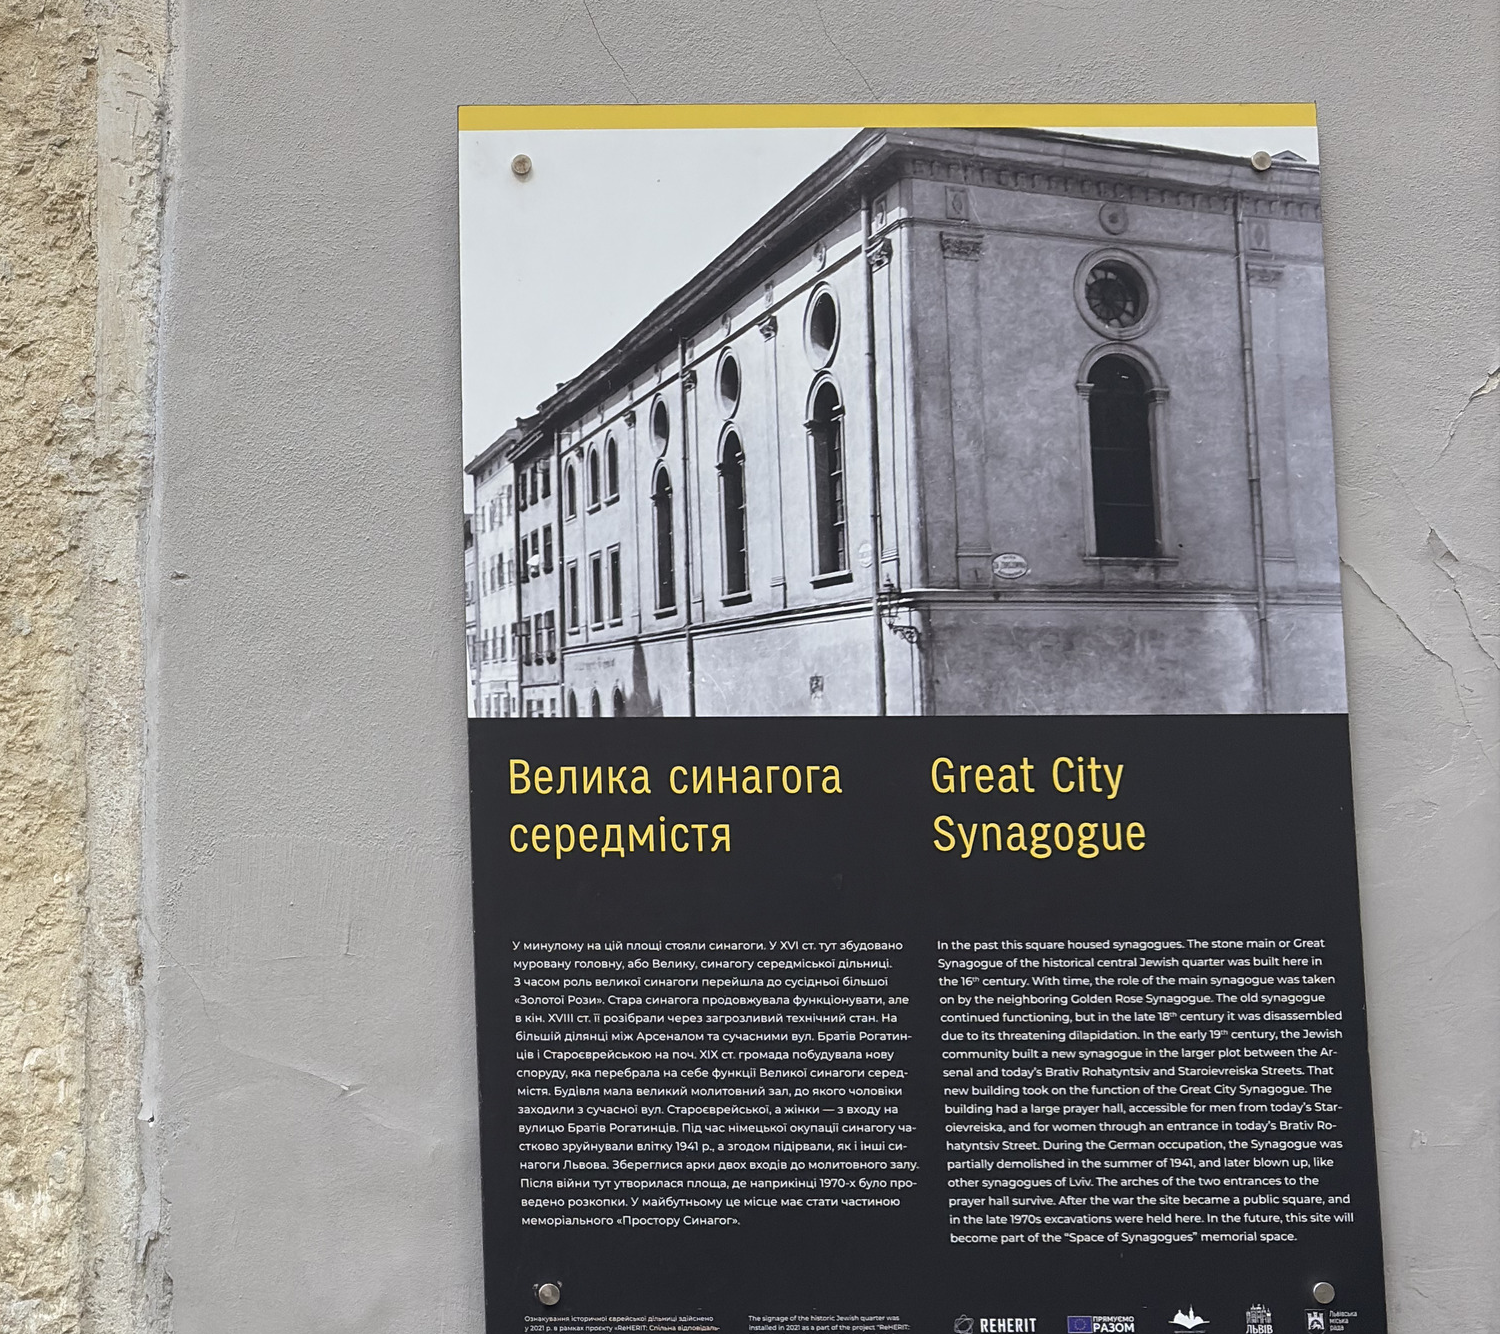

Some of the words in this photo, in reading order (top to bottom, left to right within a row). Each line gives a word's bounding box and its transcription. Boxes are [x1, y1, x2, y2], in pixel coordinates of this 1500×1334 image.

[509, 758, 651, 794] Велика
[669, 765, 842, 794] синагога
[931, 757, 1035, 793] Great
[1052, 756, 1123, 799] City
[509, 815, 730, 859] середмістя
[933, 815, 1145, 858] Synagogue
[512, 940, 520, 950] У
[523, 942, 584, 952] минулому
[587, 942, 601, 950] на
[604, 940, 623, 951] цій
[626, 940, 662, 951] площі
[664, 942, 706, 950] стояли
[708, 942, 766, 950] синагоги.
[768, 940, 777, 950] У
[779, 940, 798, 950] XVI
[801, 942, 816, 950] ст.
[818, 942, 837, 952] тут
[839, 940, 903, 952] збудовано
[937, 940, 948, 949] In
[950, 939, 971, 949] the
[973, 941, 999, 951] past
[1001, 939, 1023, 949] this
[1024, 941, 1065, 951] square
[1067, 939, 1110, 949] housed
[1112, 941, 1185, 951] synagogues.
[1186, 938, 1209, 948] The
[1211, 940, 1243, 948] stone
[1246, 938, 1276, 948] main
[1293, 938, 1325, 947] Great
[513, 976, 521, 986] З
[523, 978, 560, 986] часом
[563, 978, 592, 988] роль
[595, 976, 641, 986] великої
[643, 978, 698, 986] синагоги
[701, 977, 764, 988] перейшла
[766, 978, 782, 987] до
[784, 976, 839, 988] сусідньої
[842, 976, 888, 986] більшої
[939, 996, 954, 1004] on
[957, 994, 972, 1006] by
[973, 994, 994, 1004] the
[996, 994, 1068, 1006] neighboring
[1070, 993, 1112, 1003] Golden
[1114, 993, 1143, 1003] Rose
[1145, 993, 1214, 1005] Synagogue.
[1214, 993, 1237, 1002] The
[1239, 992, 1258, 1002] old
[1260, 994, 1325, 1004] synagogue
[524, 1012, 545, 1022] кін.
[547, 1013, 573, 1022] XVIII
[593, 1012, 600, 1022] її
[603, 1012, 664, 1024] розібрали
[667, 1015, 703, 1024] через
[705, 1013, 783, 1024] загрозливий
[785, 1012, 846, 1022] технічний
[881, 1013, 897, 1022] На
[516, 1049, 534, 1060] ців
[537, 1049, 540, 1059] і
[543, 1049, 652, 1060] Староєврейською
[654, 1051, 669, 1059] на
[672, 1051, 697, 1059] поч.
[699, 1049, 718, 1059] XIX
[721, 1051, 736, 1059] ст.
[738, 1051, 789, 1060] громада
[792, 1049, 862, 1061] побудувала
[865, 1051, 894, 1061] нову
[941, 1048, 1009, 1060] community
[1011, 1048, 1039, 1058] built
[1041, 1050, 1048, 1058] a
[1051, 1050, 1076, 1058] new
[1078, 1050, 1143, 1060] synagogue
[1144, 1047, 1156, 1057] in
[1158, 1047, 1179, 1057] the
[1181, 1047, 1215, 1059] larger
[1217, 1047, 1241, 1059] plot
[1243, 1047, 1294, 1057] between
[1297, 1047, 1318, 1056] the
[1319, 1047, 1337, 1056] Ar-
[944, 1103, 992, 1115] building
[995, 1103, 1018, 1113] had
[1020, 1105, 1028, 1113] a
[1030, 1103, 1060, 1115] large
[1062, 1105, 1100, 1115] prayer
[1101, 1102, 1126, 1113] hall,
[1128, 1102, 1188, 1112] accessible
[1189, 1102, 1206, 1112] for
[1208, 1104, 1236, 1112] men
[1237, 1101, 1267, 1112] from
[1313, 1101, 1342, 1111] Star-
[518, 1124, 564, 1134] вулицю
[567, 1122, 606, 1134] Братів
[609, 1122, 679, 1133] Рогатинців.
[681, 1122, 702, 1133] Під
[704, 1124, 725, 1132] час
[728, 1122, 787, 1133] німецької
[789, 1122, 839, 1134] окупації
[841, 1124, 895, 1134] синагогу
[897, 1124, 916, 1132] ча-
[946, 1140, 1000, 1152] hatyntsiv
[1001, 1140, 1040, 1150] Street.
[1042, 1140, 1083, 1152] During
[1085, 1140, 1106, 1149] the
[1107, 1140, 1155, 1149] German
[1157, 1139, 1226, 1150] occupation,
[1227, 1138, 1248, 1148] the
[1250, 1139, 1317, 1150] Synagogue
[1319, 1140, 1343, 1148] was
[520, 1198, 565, 1207] ведено
[567, 1198, 628, 1208] розкопки.
[630, 1196, 639, 1206] У
[642, 1196, 722, 1208] майбутньому
[725, 1198, 740, 1207] це
[743, 1196, 777, 1207] місце
[780, 1198, 803, 1206] має
[805, 1198, 838, 1206] стати
[840, 1198, 900, 1206] частиною
[980, 1318, 1037, 1333] REHERIT
[1093, 1323, 1135, 1333] РАЗОМ
[1246, 1324, 1273, 1334] ЛЬВІВ
